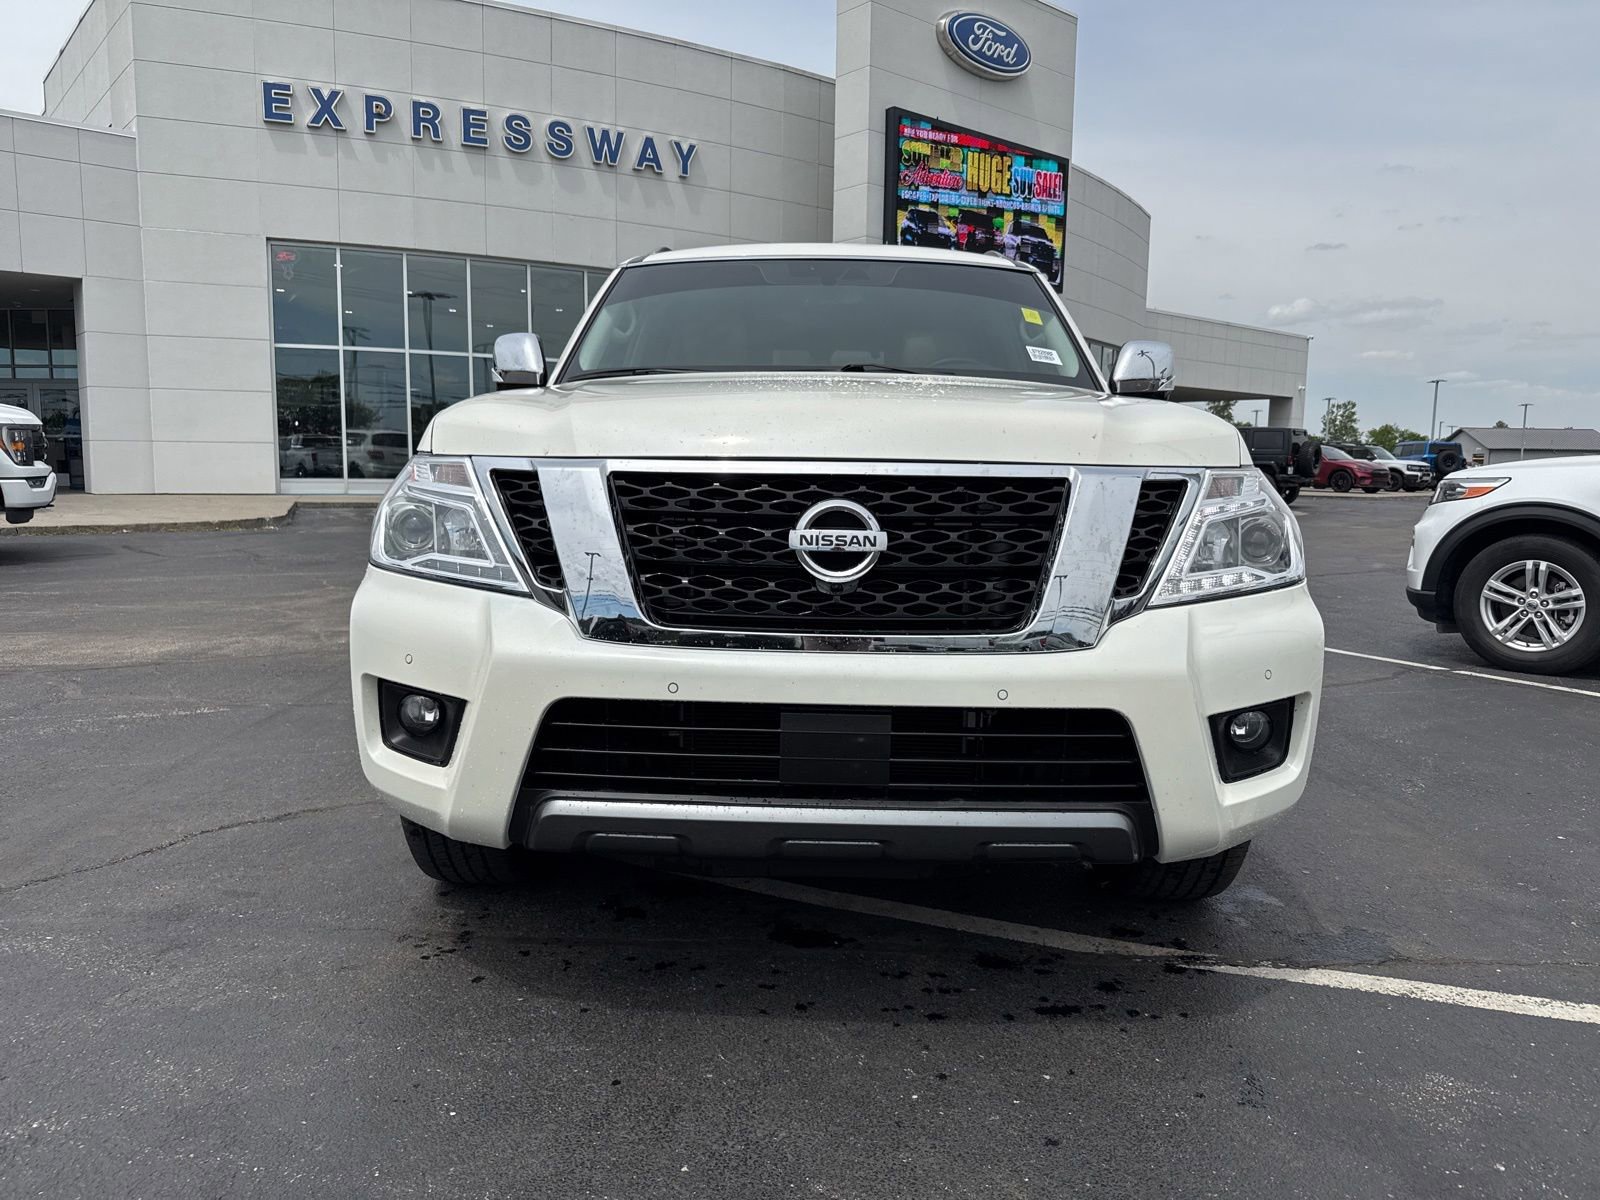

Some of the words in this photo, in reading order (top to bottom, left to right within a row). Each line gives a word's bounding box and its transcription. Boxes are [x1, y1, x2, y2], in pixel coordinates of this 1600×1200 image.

[968, 21, 1019, 65] Ford
[260, 79, 699, 177] EXPRESSWAY
[966, 150, 1013, 196] HUGE
[1011, 166, 1036, 199] SUV
[1034, 168, 1064, 202] SALE!
[799, 534, 878, 548] NISSAN
